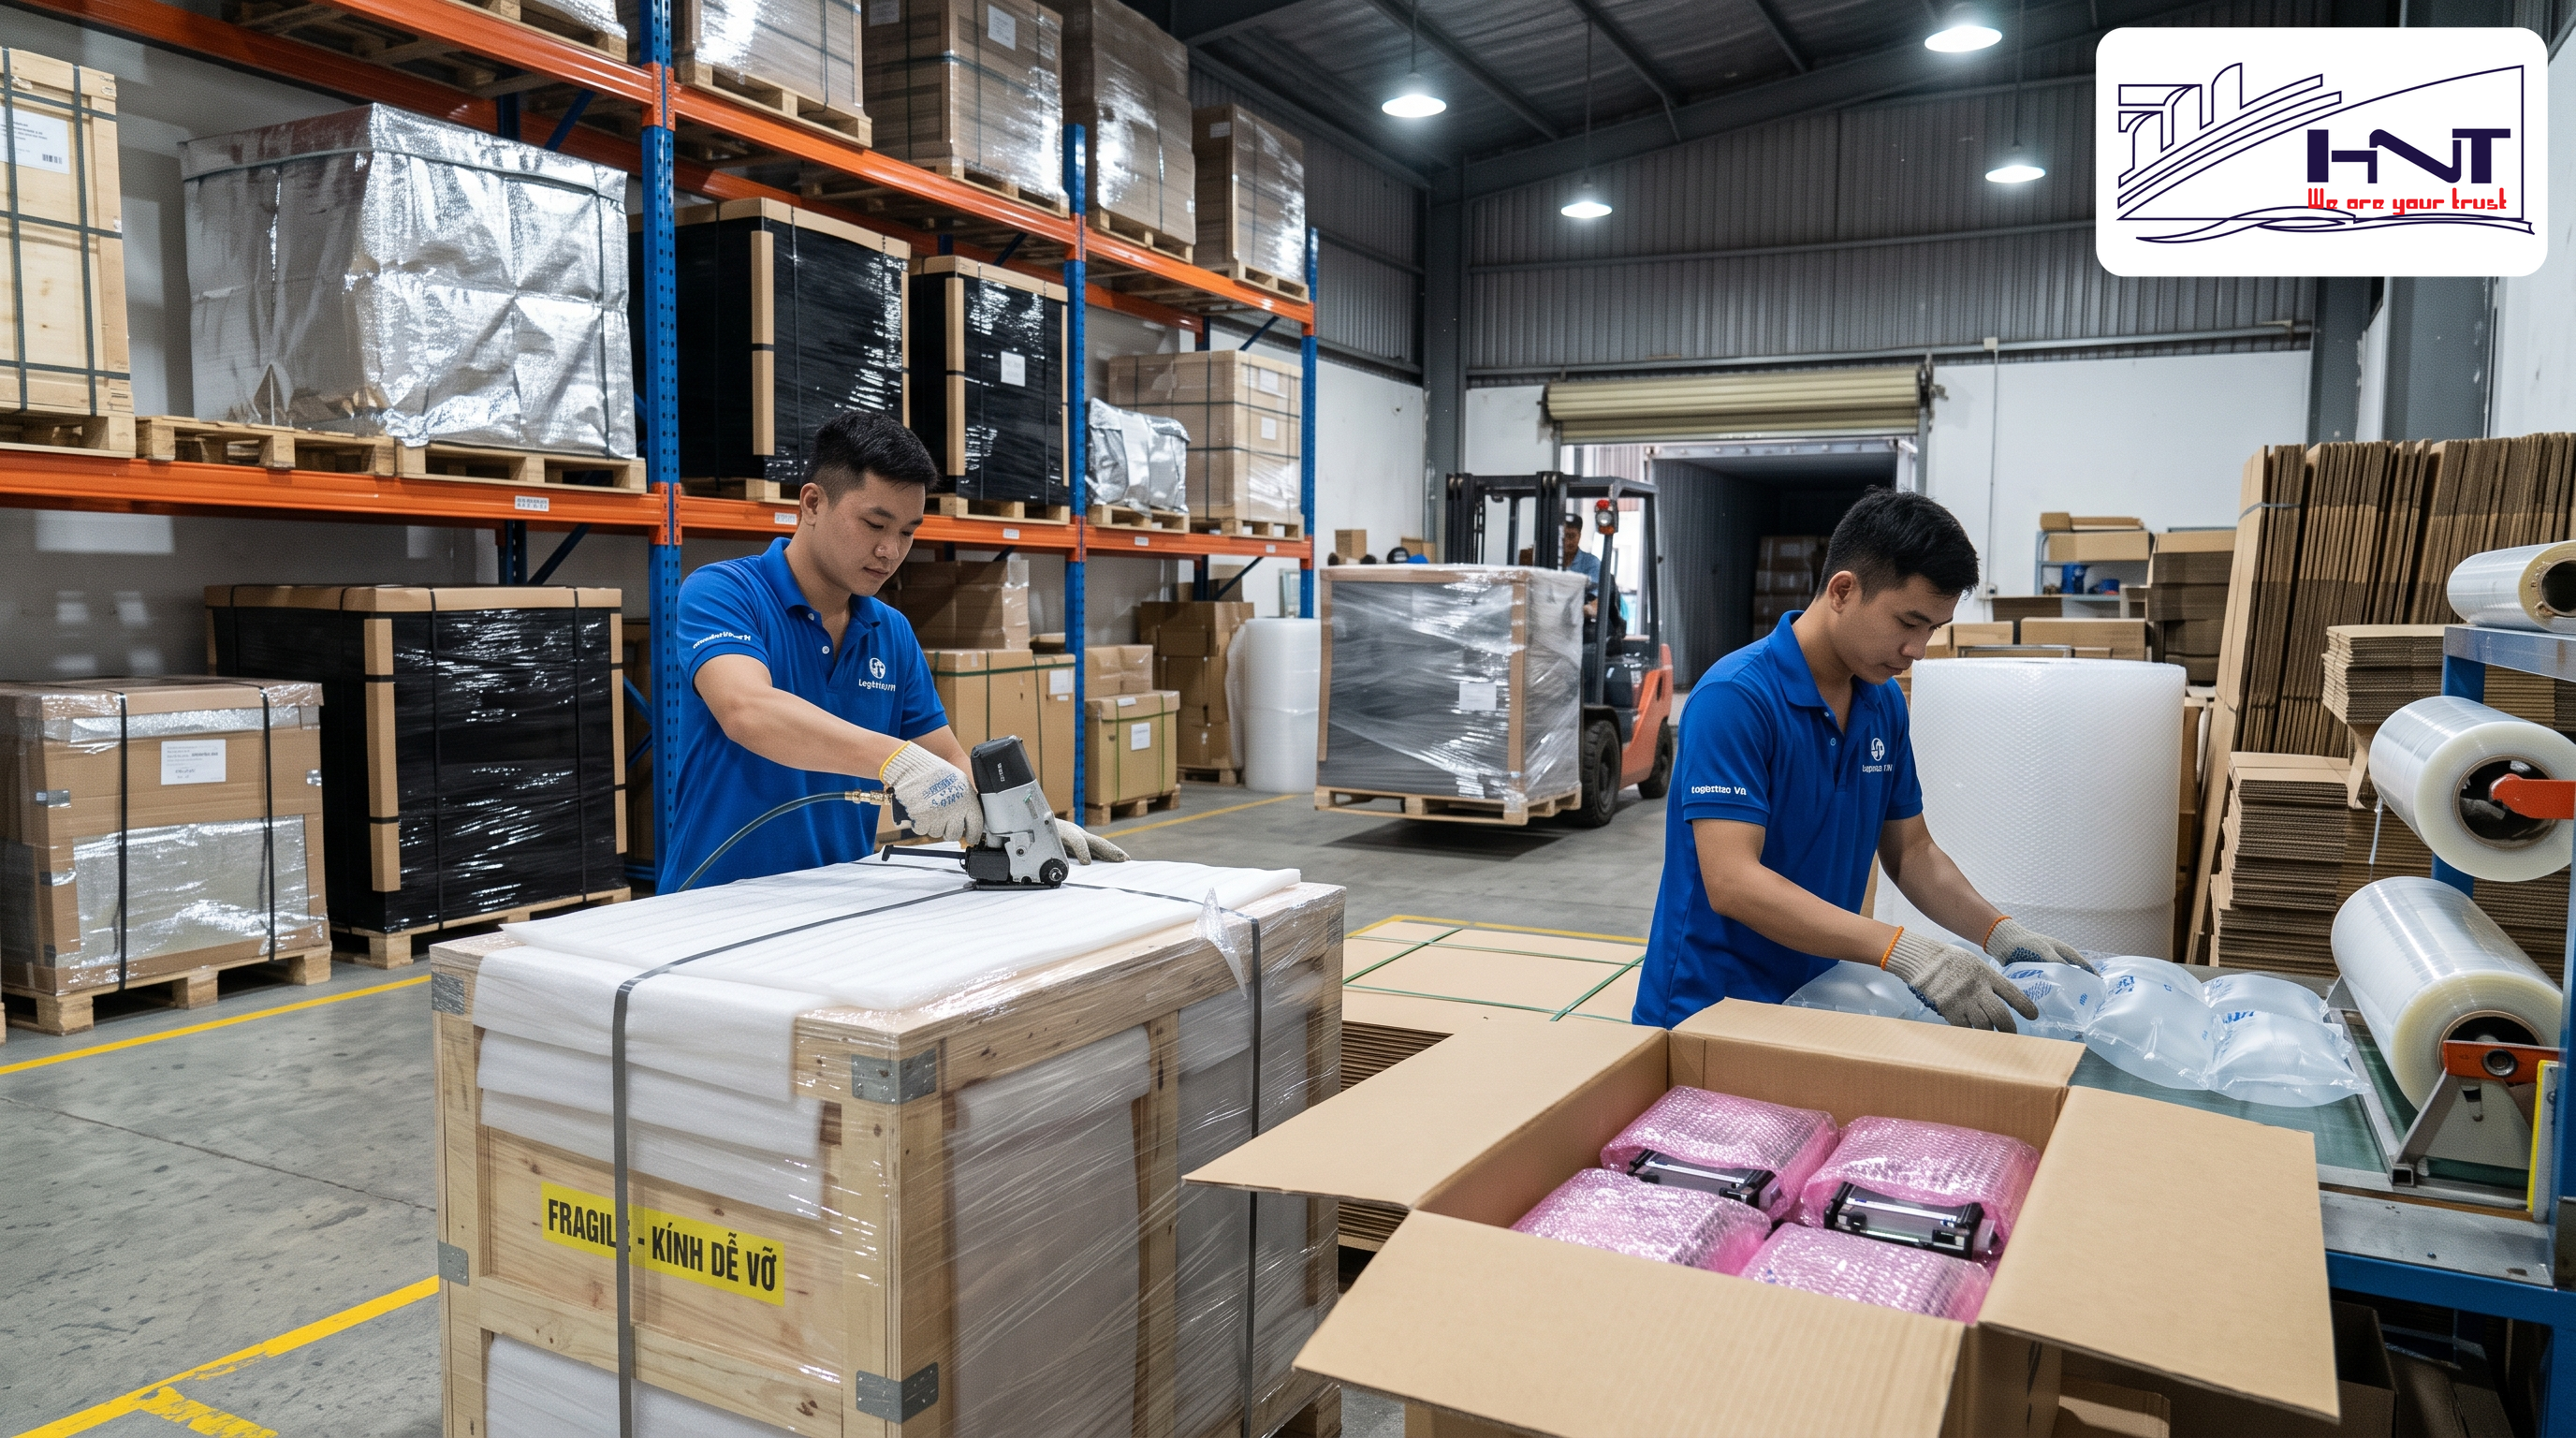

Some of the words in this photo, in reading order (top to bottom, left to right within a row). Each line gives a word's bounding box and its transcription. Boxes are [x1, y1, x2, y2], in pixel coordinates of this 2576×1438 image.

[651, 1222, 703, 1273] KÍNH
[711, 1231, 739, 1283] DỄ
[746, 1246, 777, 1292] VỠ
